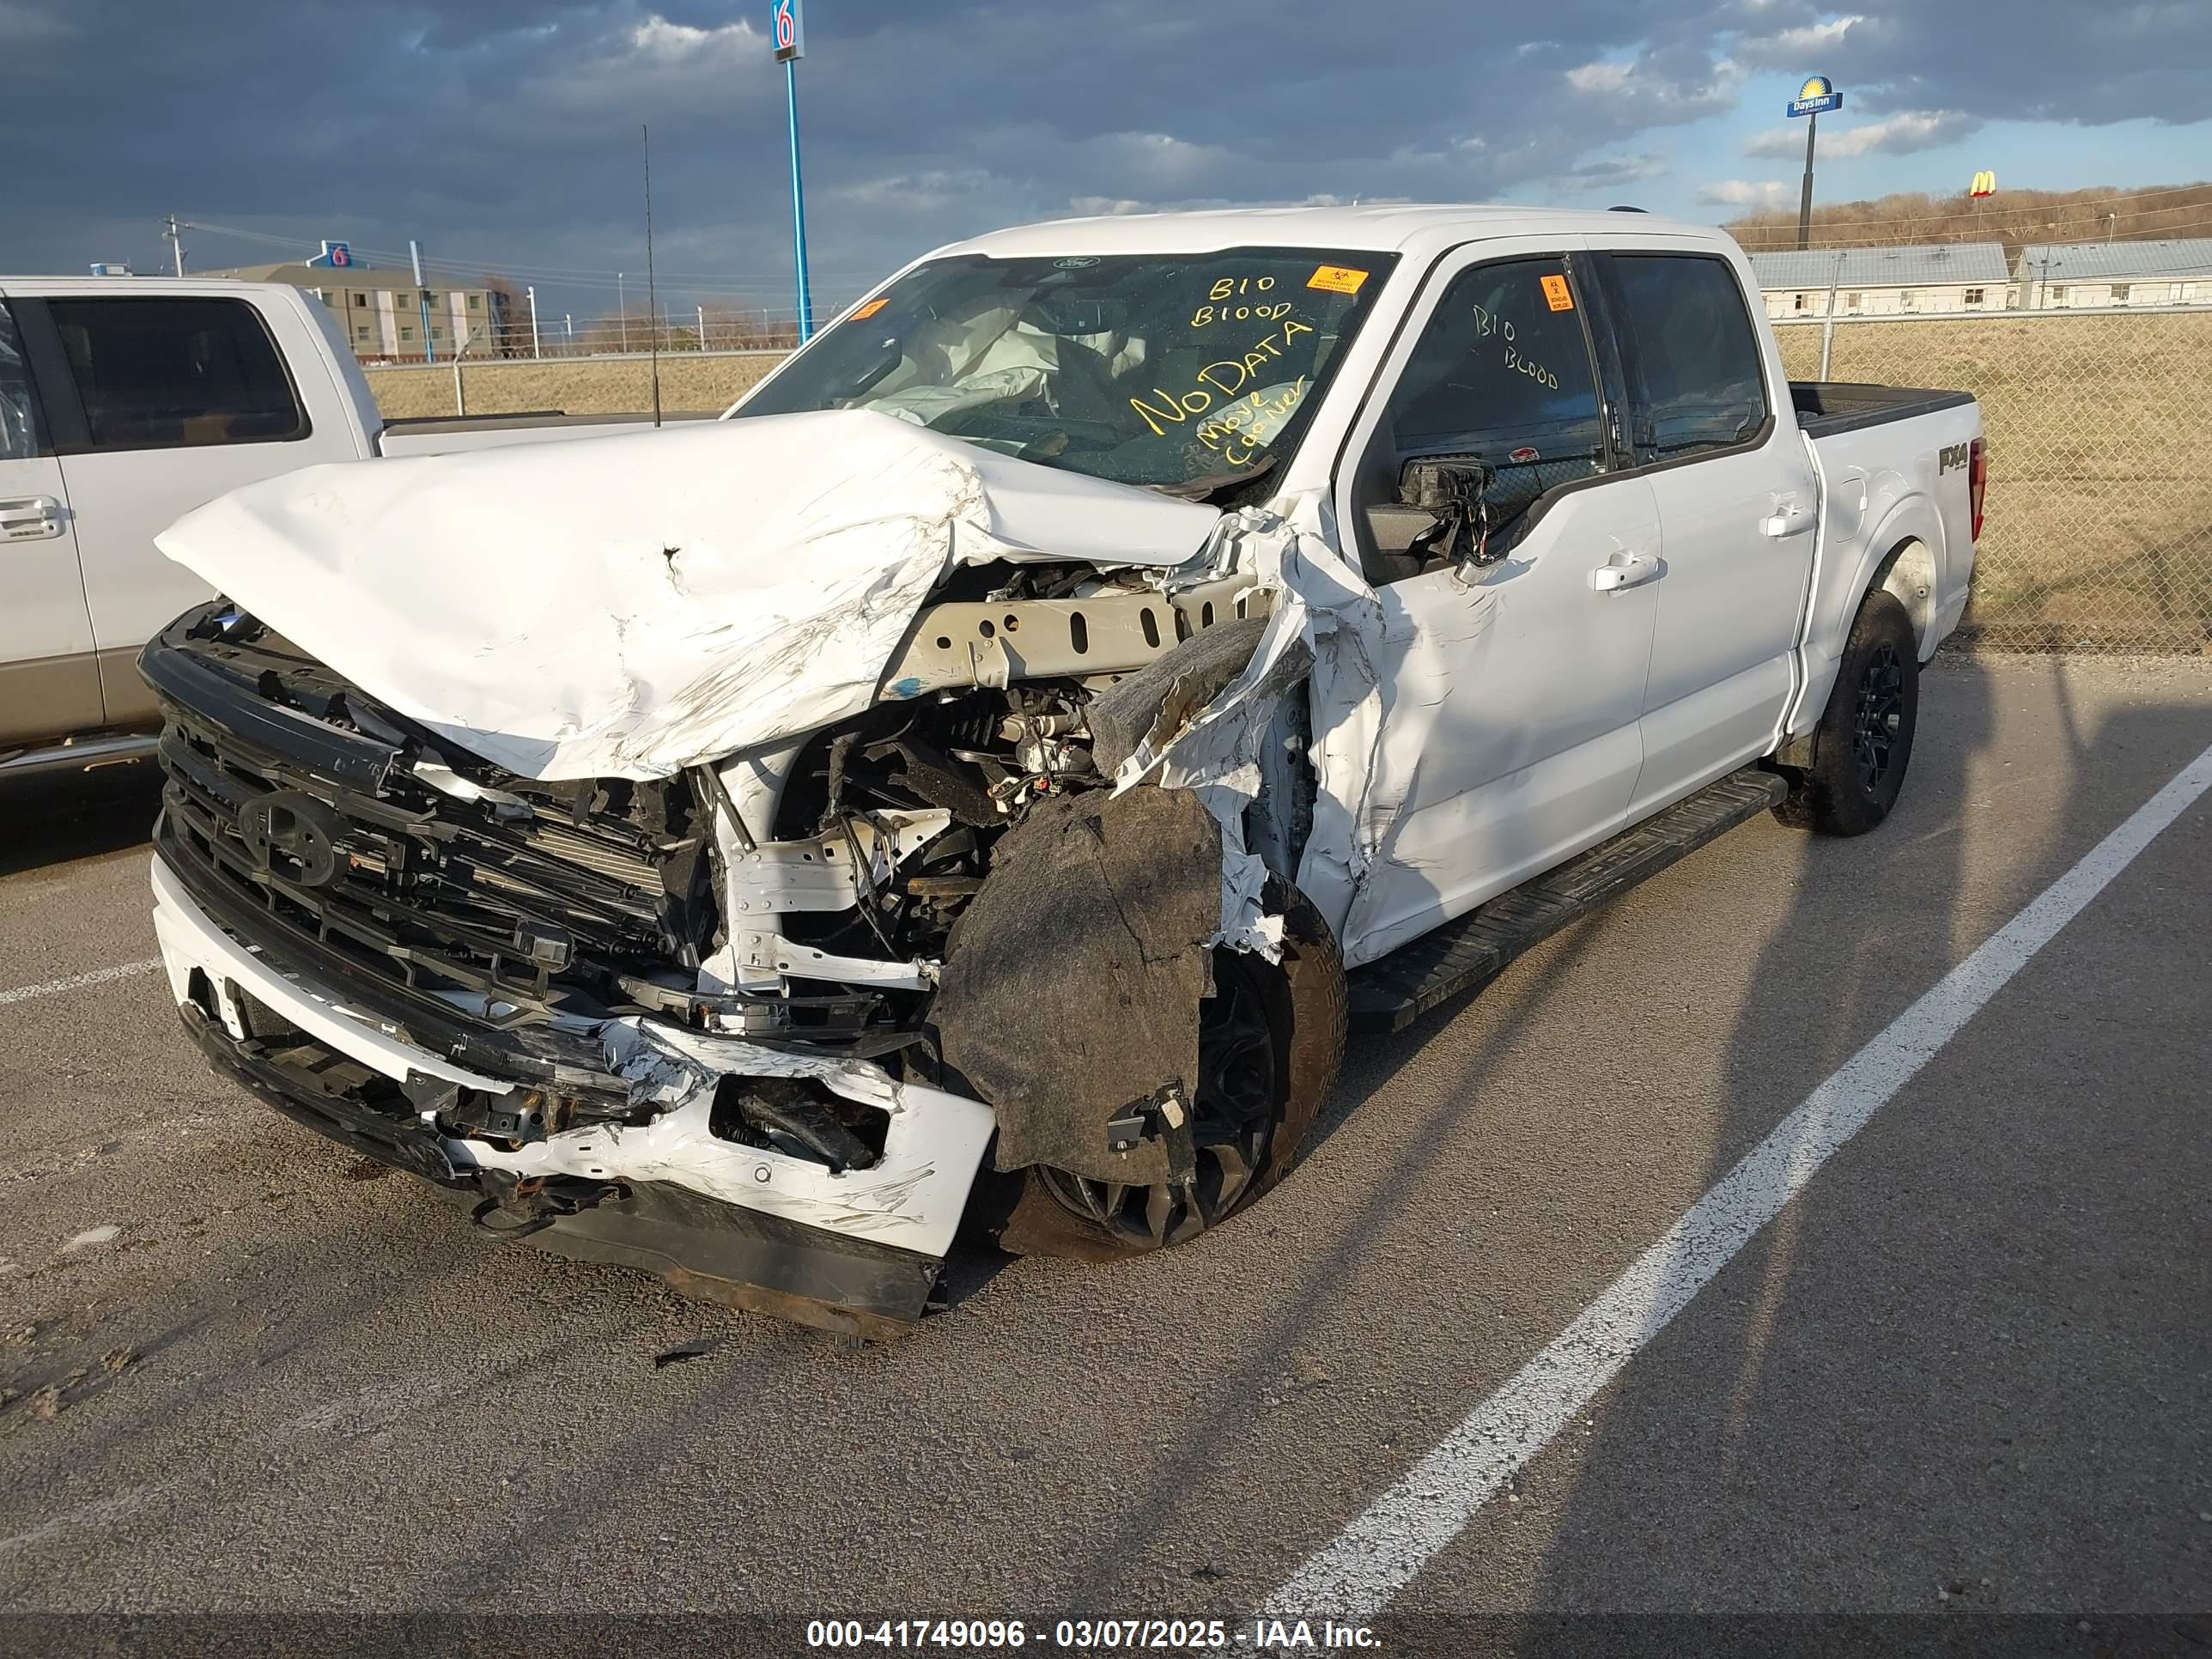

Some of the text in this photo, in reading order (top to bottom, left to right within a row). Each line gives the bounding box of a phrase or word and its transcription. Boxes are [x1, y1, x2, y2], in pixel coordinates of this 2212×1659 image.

[777, 0, 794, 49] 6
[1793, 100, 1814, 112] Days
[1814, 97, 1830, 106] Inn
[332, 246, 348, 266] 6
[1210, 276, 1275, 301] BIO
[1473, 304, 1516, 342] BIO
[1197, 320, 1313, 396] DATA
[1504, 345, 1559, 390] BLOOD
[1939, 441, 1967, 476] FX4
